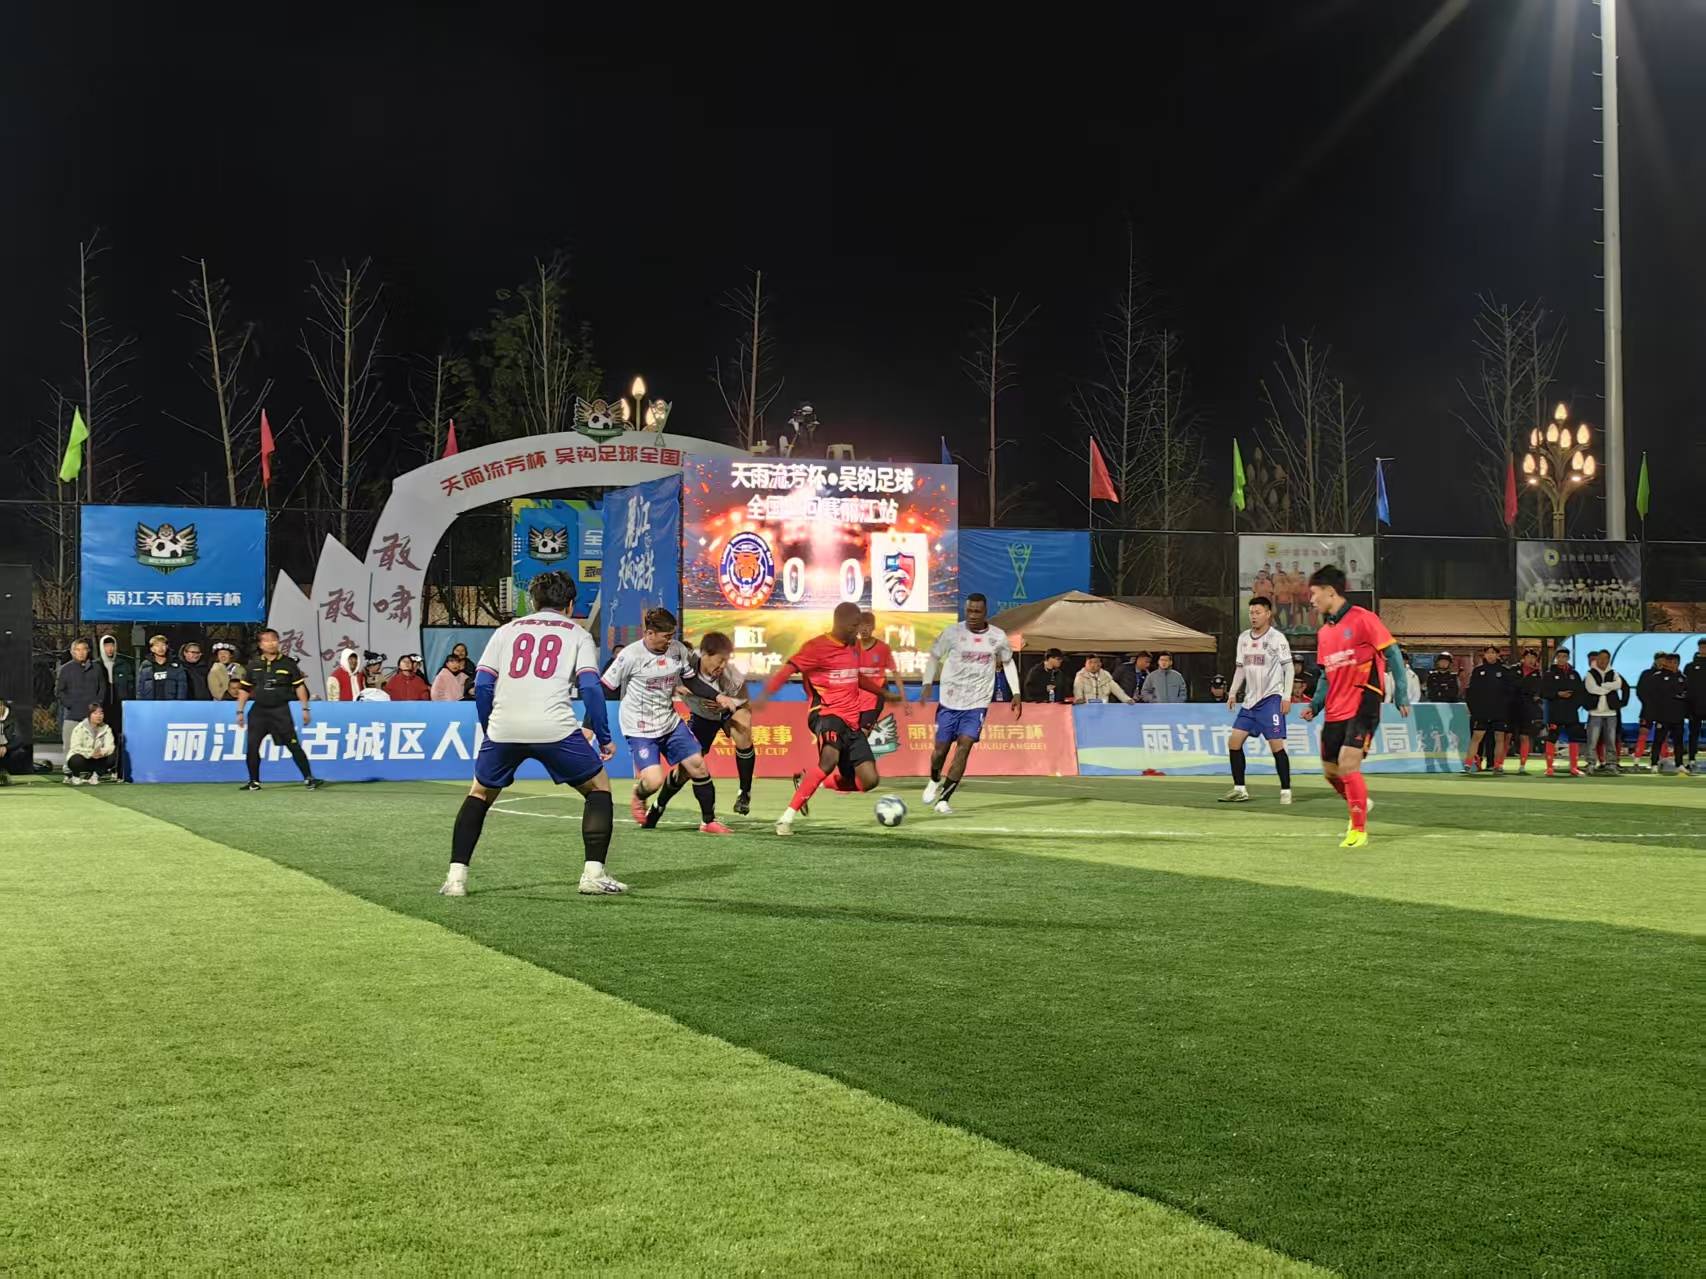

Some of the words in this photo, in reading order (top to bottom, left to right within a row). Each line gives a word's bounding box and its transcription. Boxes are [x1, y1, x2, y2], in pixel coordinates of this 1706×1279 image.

[440, 451, 547, 496] 天雨流芳杯
[747, 494, 898, 524] 全国回赛丽江站
[107, 590, 242, 607] 丽江天雨流芳杯
[783, 557, 806, 603] 0
[839, 558, 864, 603] 0
[509, 632, 563, 679] 88
[1272, 713, 1280, 726] 9
